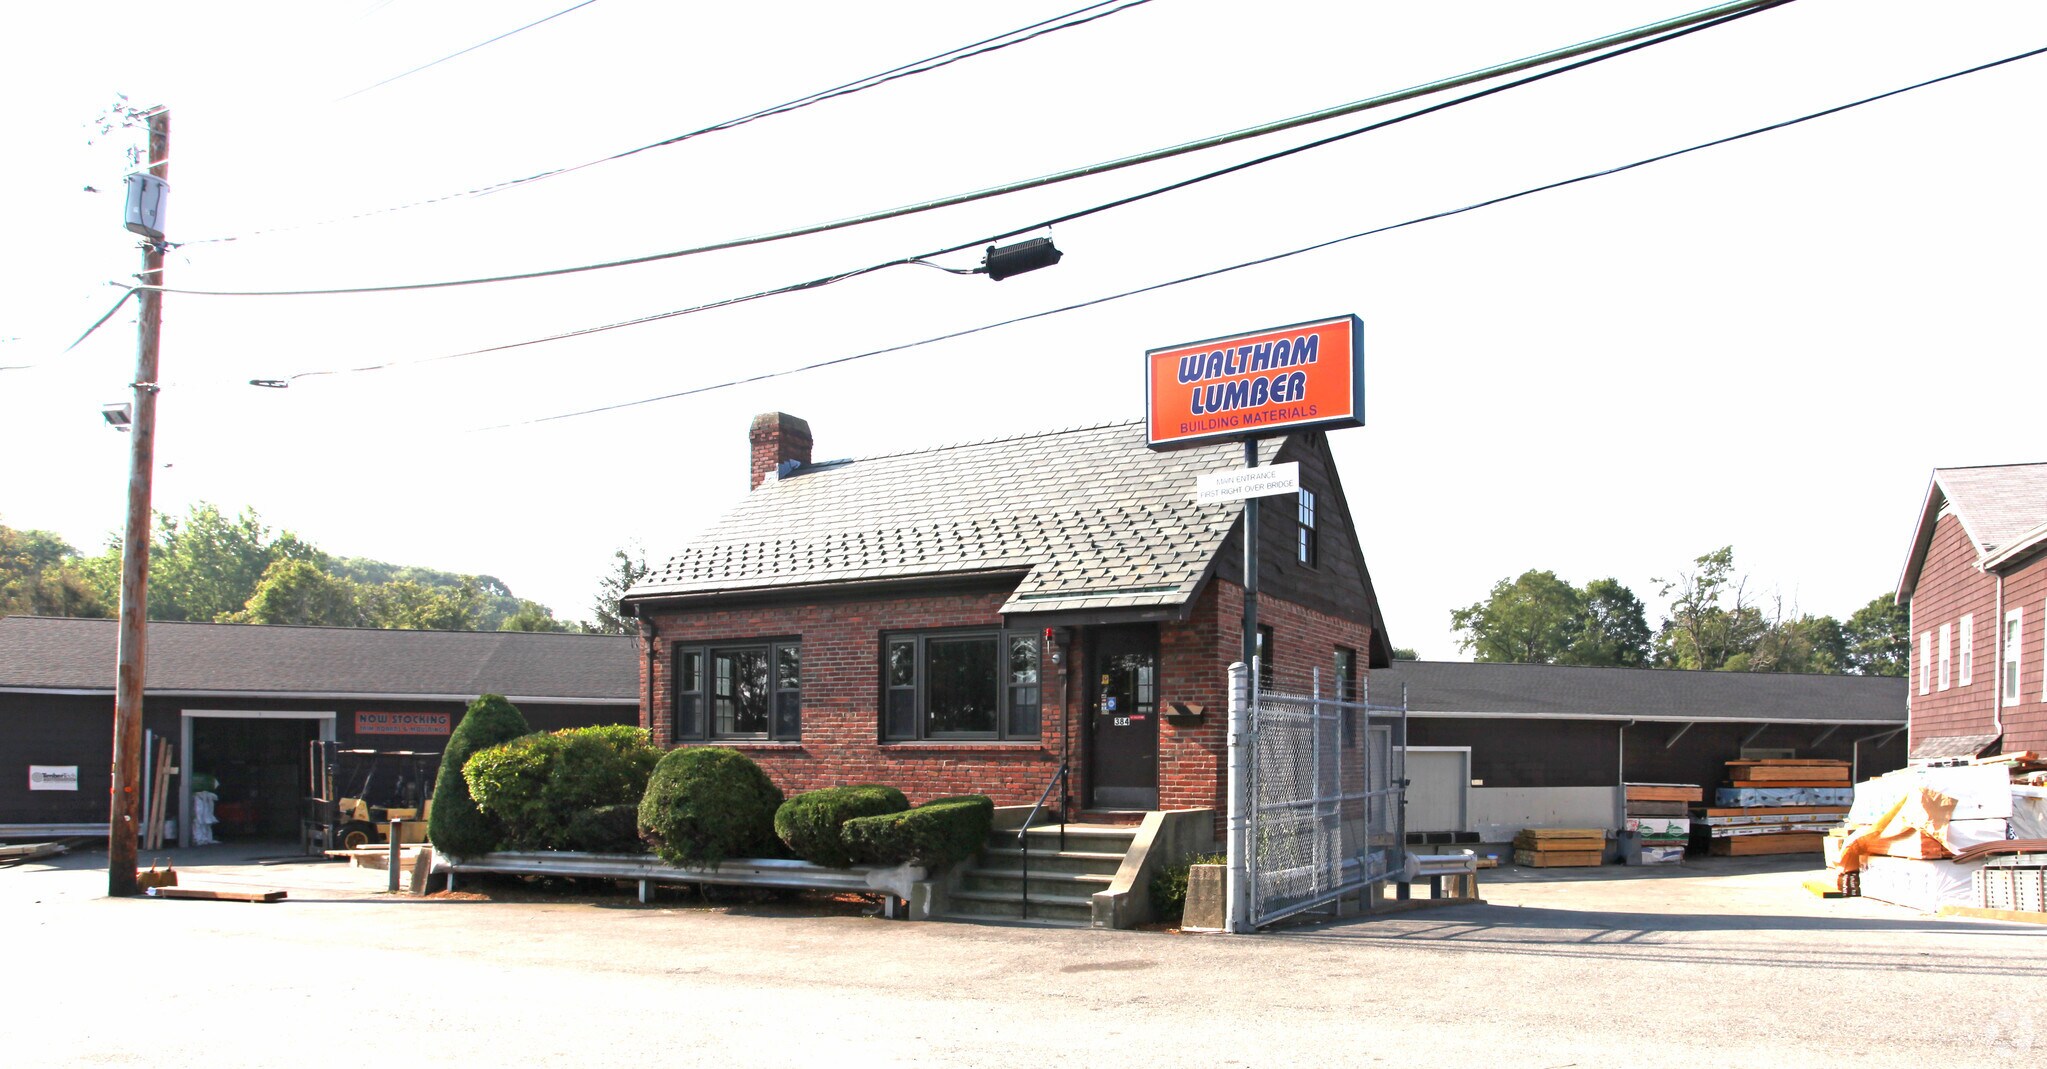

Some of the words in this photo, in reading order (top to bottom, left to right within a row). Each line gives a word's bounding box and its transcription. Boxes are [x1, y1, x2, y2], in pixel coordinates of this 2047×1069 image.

[1178, 334, 1319, 384] WALTHAM
[1191, 370, 1306, 415] LUMBER
[1180, 416, 1239, 433] BUILDING
[1243, 404, 1318, 424] MATERIALS
[1236, 470, 1276, 483] ENTRANCE
[1200, 489, 1219, 499] FIRST
[1220, 486, 1242, 497] RIGHT
[1244, 483, 1265, 493] OVER
[1266, 479, 1294, 490] BRIDGE
[360, 714, 387, 723] NOW
[392, 715, 447, 724] STOCKING
[1115, 717, 1129, 725] 384
